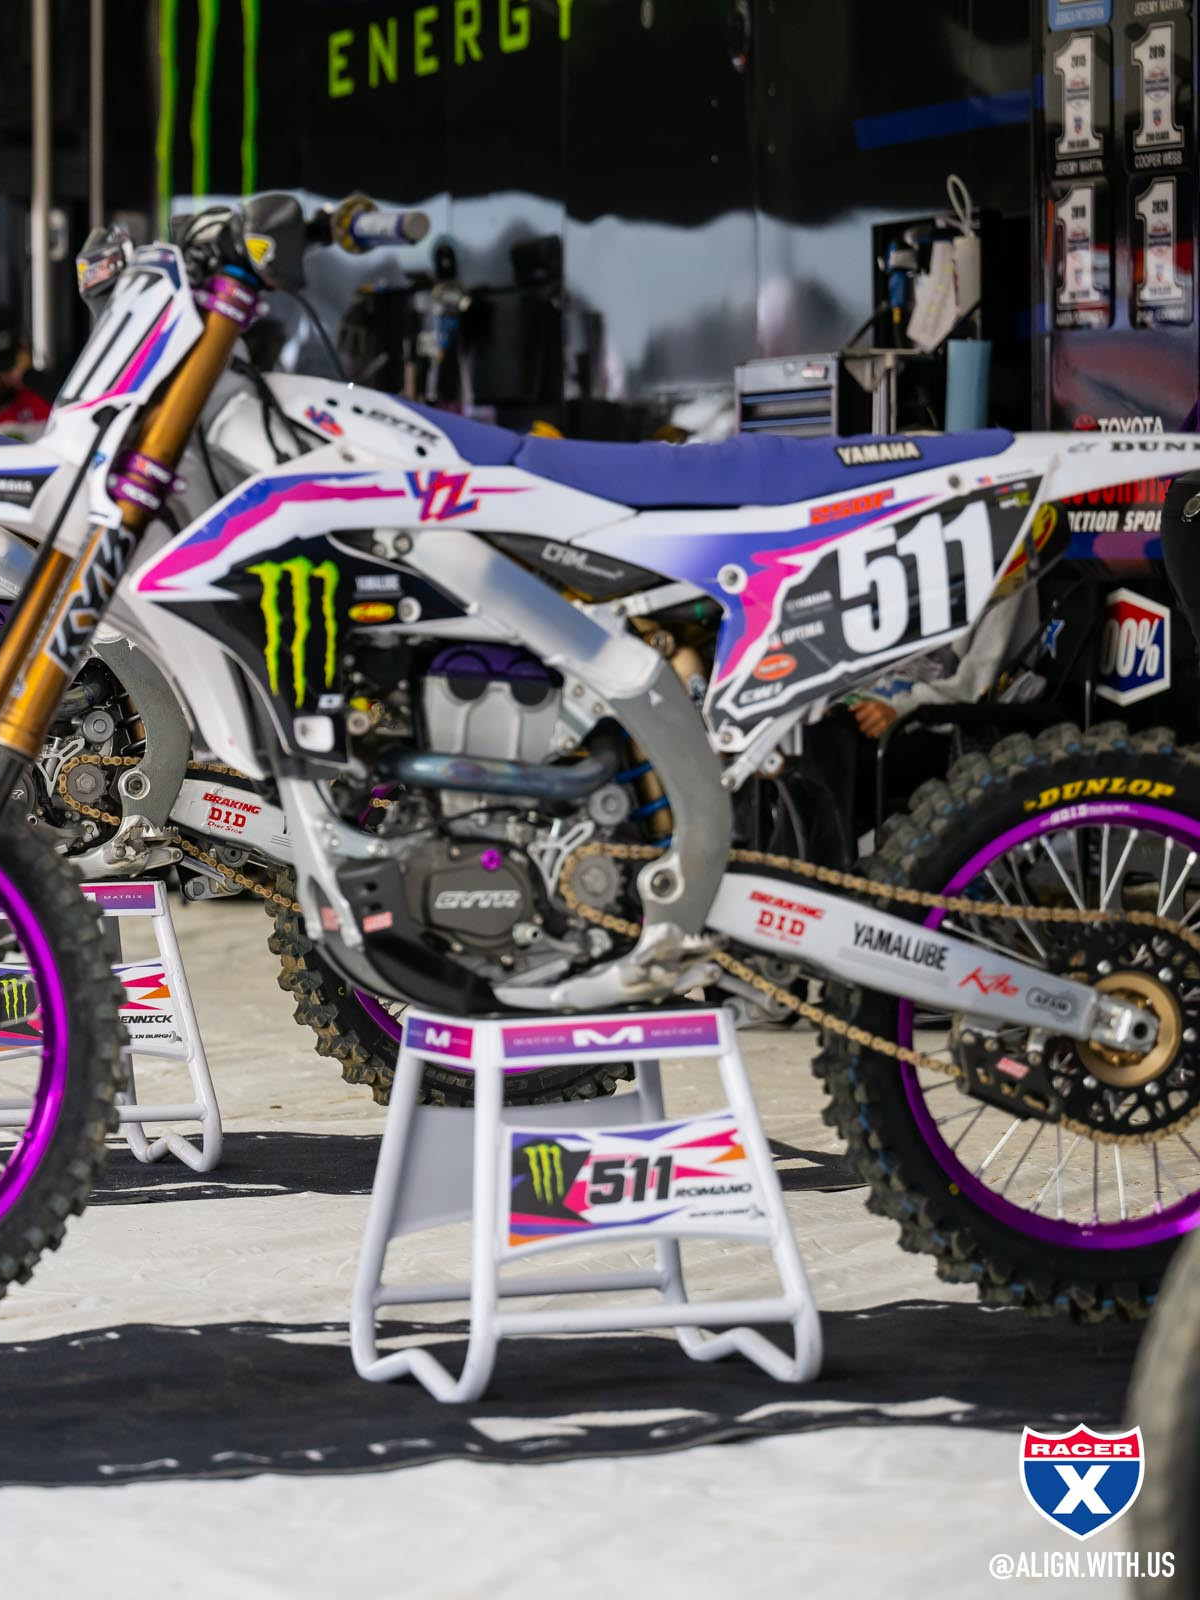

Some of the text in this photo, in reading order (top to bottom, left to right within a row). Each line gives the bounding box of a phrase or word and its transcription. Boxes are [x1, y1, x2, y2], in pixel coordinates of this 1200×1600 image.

[1097, 416, 1164, 432] TOYOTA
[836, 442, 921, 465] YAMAHA
[837, 500, 996, 654] 511
[203, 792, 262, 815] BRAKING
[1036, 777, 1176, 810] DUNLOP
[853, 922, 950, 971] YAMALUBE
[119, 1015, 174, 1024] ENNICK
[589, 1155, 673, 1205] 511
[675, 1183, 753, 1198] ROMANO
